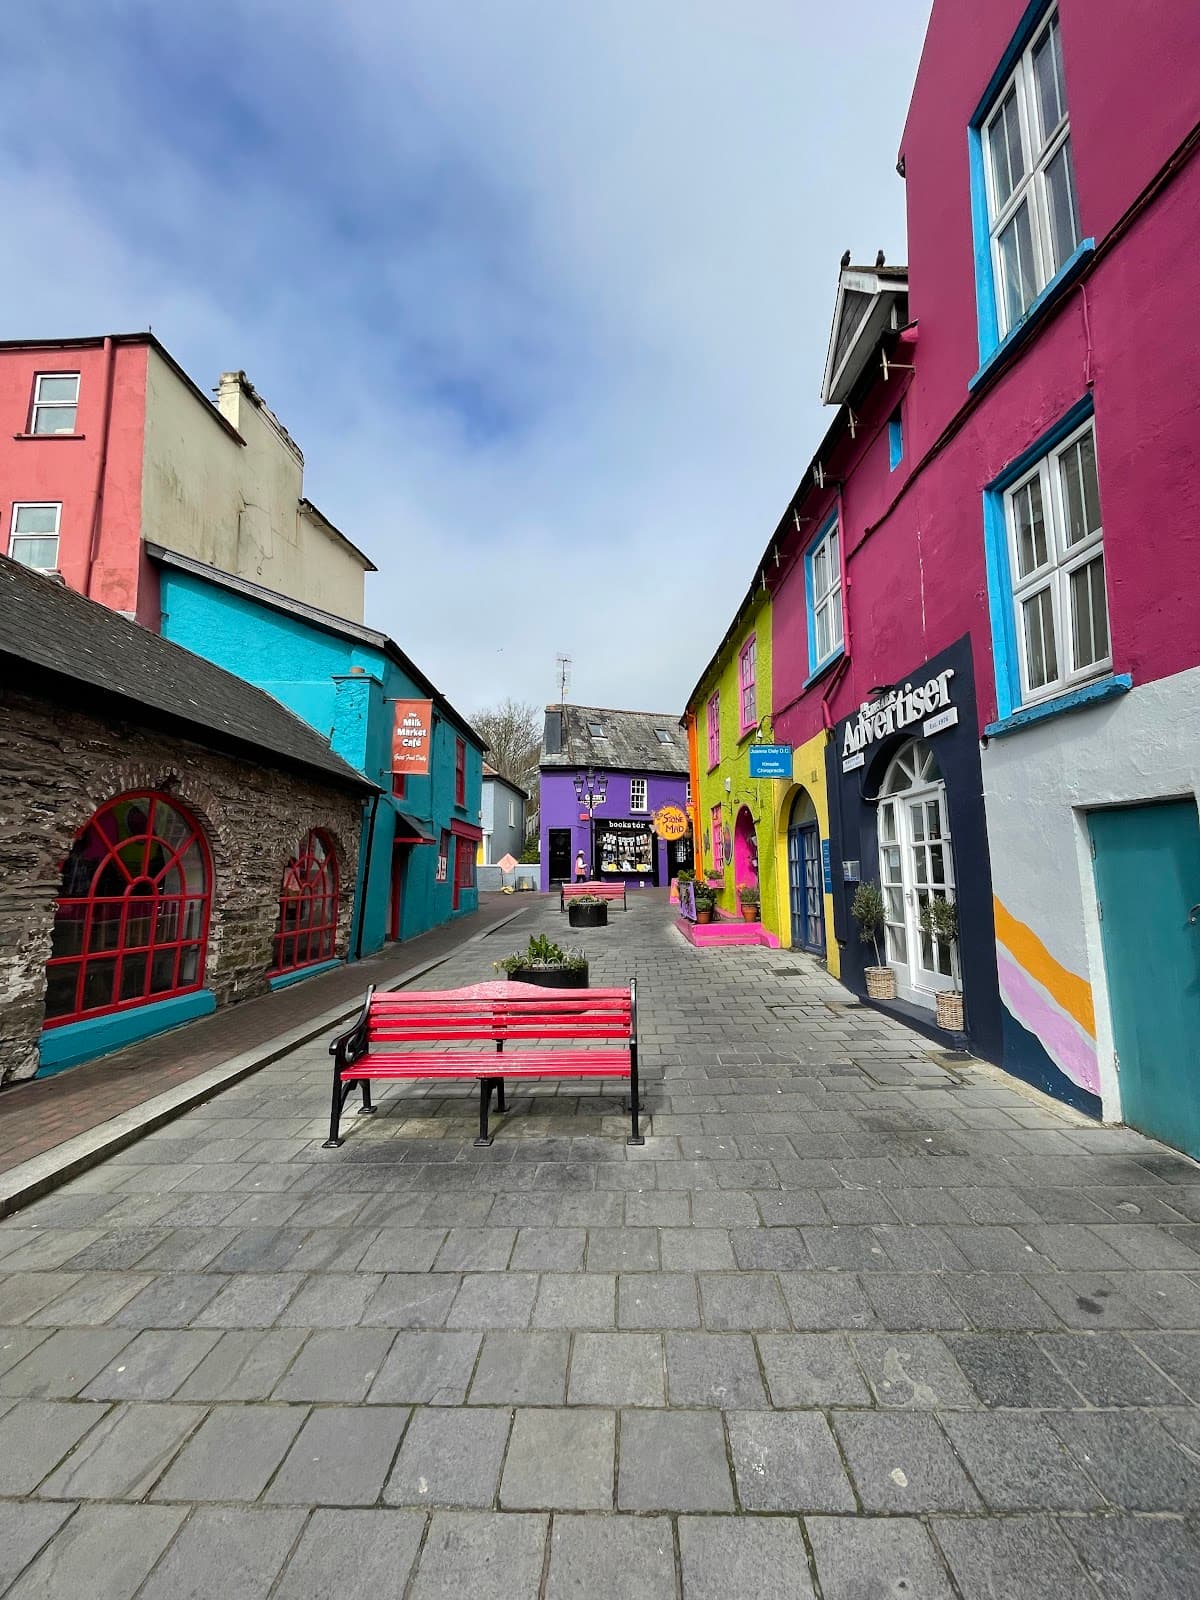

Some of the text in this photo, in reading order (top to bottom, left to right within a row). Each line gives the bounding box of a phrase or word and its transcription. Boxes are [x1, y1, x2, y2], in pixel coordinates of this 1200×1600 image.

[842, 669, 955, 757] Advertiser
[403, 718, 421, 727] Milk
[397, 728, 427, 737] Market
[402, 738, 422, 748] Café
